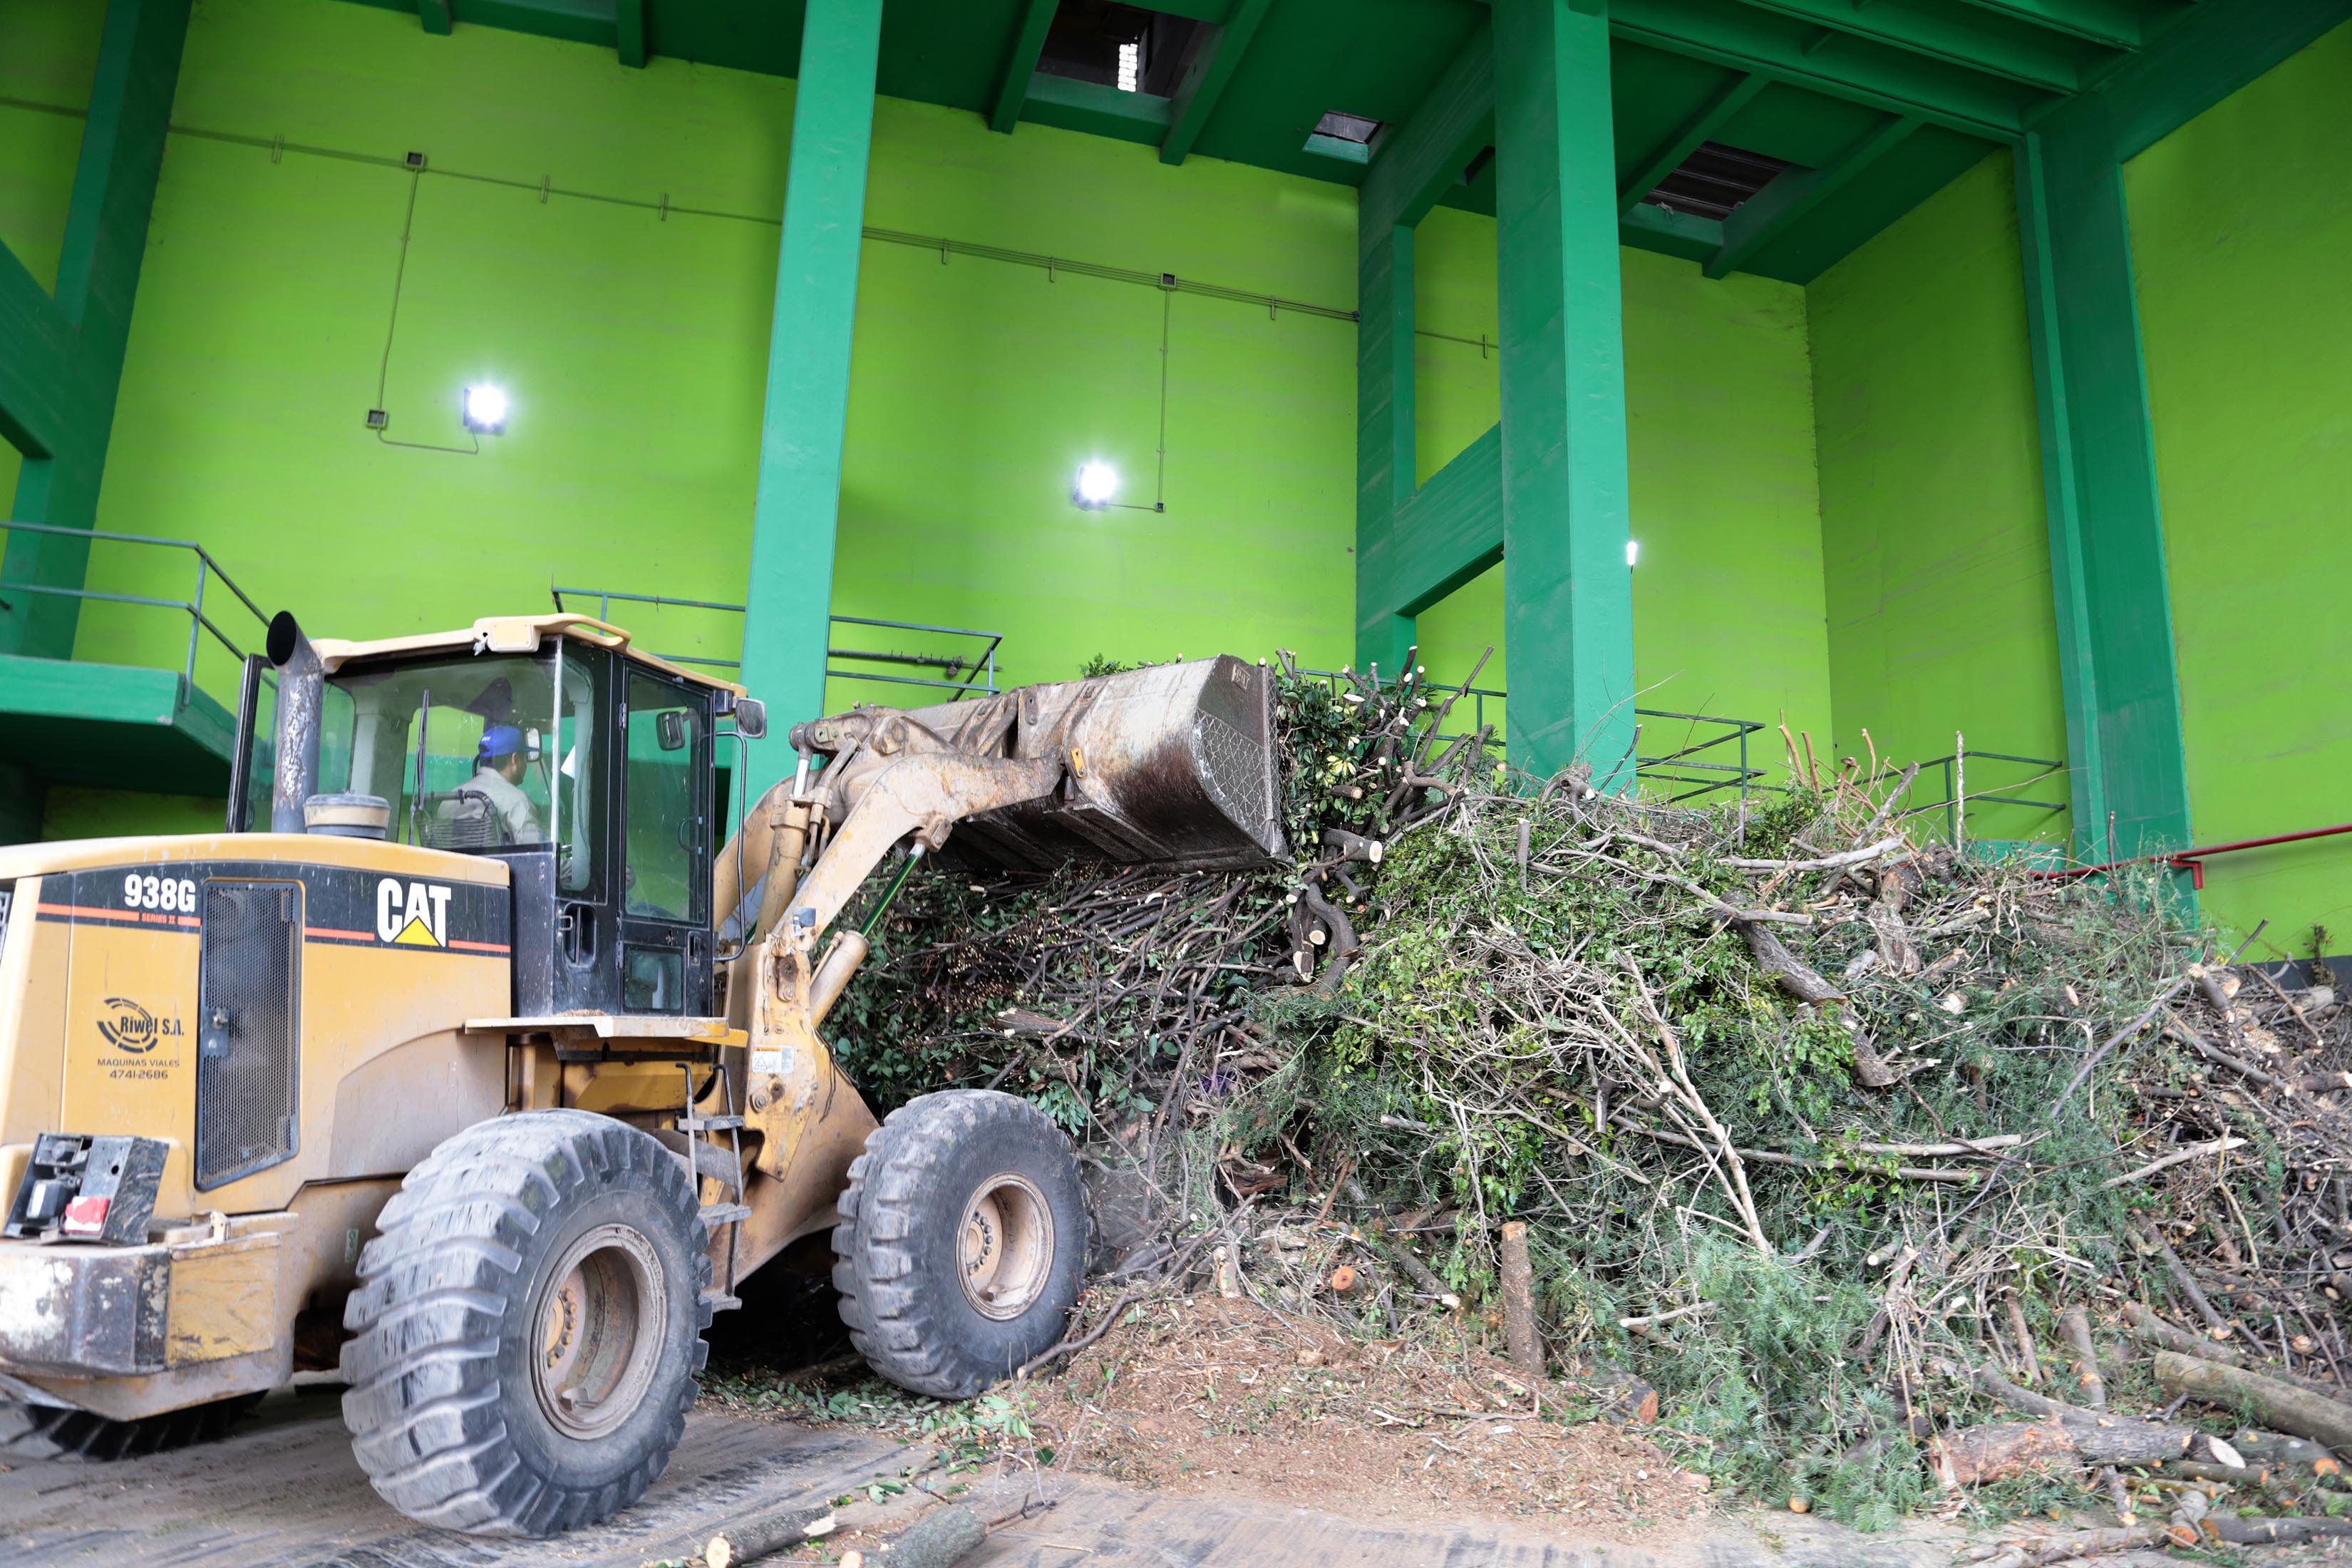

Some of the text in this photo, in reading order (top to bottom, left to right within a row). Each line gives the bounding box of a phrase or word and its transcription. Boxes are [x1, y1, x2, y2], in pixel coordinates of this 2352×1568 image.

[124, 874, 196, 912] 938G
[142, 912, 176, 924] SERIES II
[377, 877, 452, 948] CAT
[120, 1016, 185, 1036] Riwel S.A.
[97, 1058, 180, 1068] MAQUINAS VIALES
[109, 1069, 168, 1079] 4741-2686
